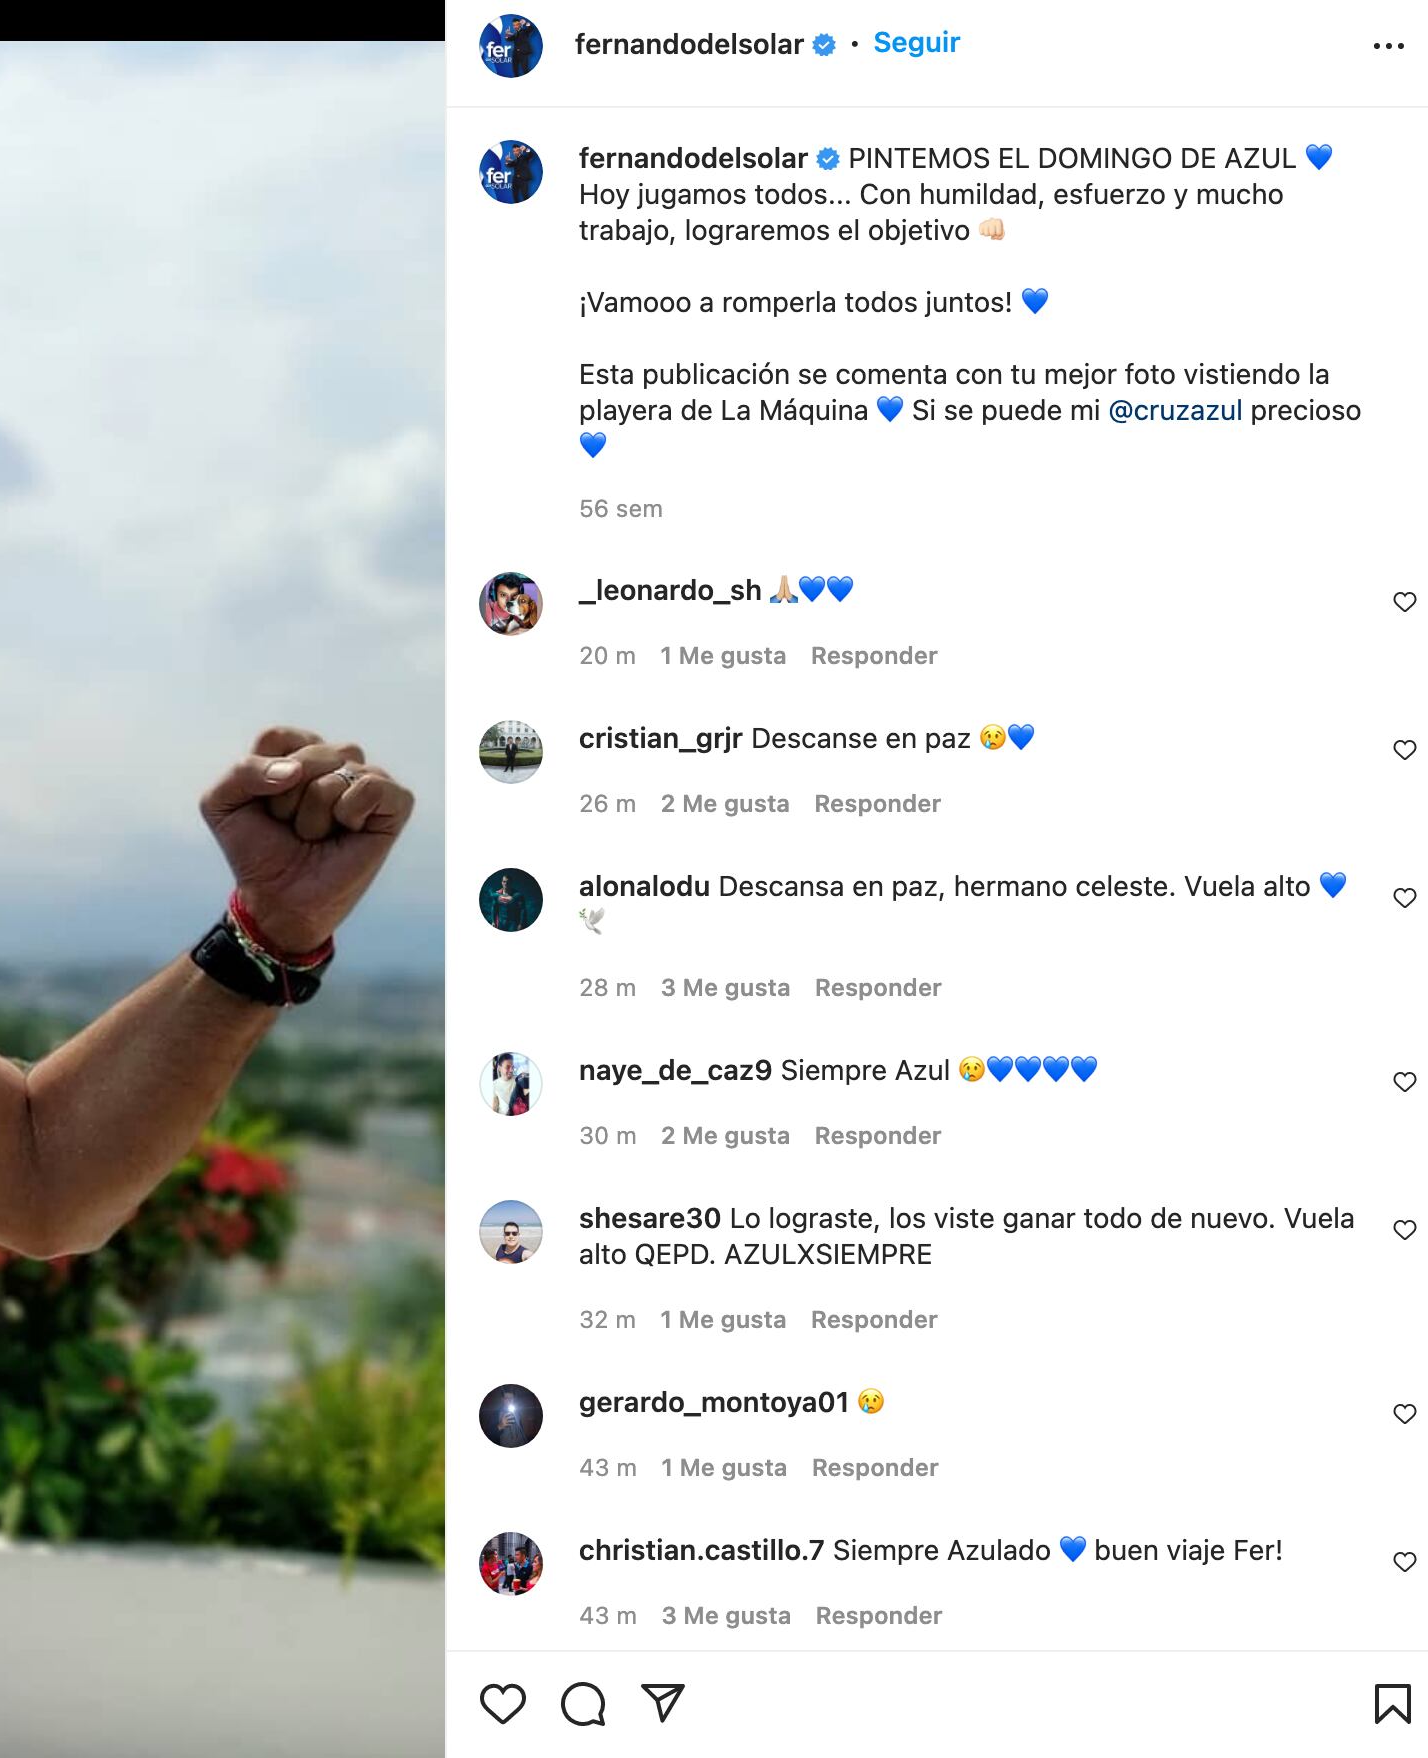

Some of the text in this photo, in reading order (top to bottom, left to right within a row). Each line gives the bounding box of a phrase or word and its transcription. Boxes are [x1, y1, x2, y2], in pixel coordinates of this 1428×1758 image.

[575, 30, 961, 58] fernandodelsolar Seguir
[579, 147, 1296, 169] fernandodelsolar PINTEMOS EL DOMINGO DE AZUL
[581, 183, 1283, 209] Hoy jugamos todos... Con humildad, esfuerzo y mucho
[579, 219, 969, 245] trabajo, lograremos el objetivo
[581, 291, 1011, 317] ¡Vamooo a romperla todos juntos!
[581, 362, 1328, 389] Esta publicación se comenta con tu mejor foto vistiendo la
[581, 398, 1361, 425] playera de La Máquina Si se puede mi @cruzazul precioso
[581, 499, 662, 517] 56 sem
[578, 579, 761, 605] _leonardo_sh
[581, 646, 635, 664] 20 m
[662, 647, 785, 669] 1 Me gusta
[813, 646, 938, 668] Responder
[580, 726, 970, 753] cristian_grjr Descanse en paz
[581, 794, 635, 812] 26 m
[662, 794, 789, 817] 2 Me gusta
[816, 794, 941, 816] Responder
[580, 875, 1310, 901] alonalodu Descansa en paz, hermano celeste. Vuela alto
[581, 978, 635, 996] 28 m
[662, 978, 789, 1000] 3 Me gusta
[817, 978, 942, 1000] Responder
[580, 1059, 949, 1085] naye_de_caz9 Siempre Azul
[581, 1126, 635, 1144] 30 m
[662, 1126, 789, 1149] 2 Me gusta
[816, 1126, 941, 1148] Responder
[580, 1207, 1354, 1233] shesare30 Lo lograste, los viste ganar todo de nuevo. Vuela
[580, 1243, 931, 1266] alto QEPD. AZULXSIEMPRE
[581, 1310, 635, 1328] 32 m
[662, 1311, 785, 1333] 1 Me gusta
[813, 1310, 938, 1332] Responder
[580, 1391, 847, 1417] gerardo_montoya01
[580, 1459, 636, 1476] 43 m
[662, 1459, 786, 1481] 1 Me gusta
[814, 1458, 939, 1480] Responder
[580, 1538, 1281, 1565] christian.castillo.7 Siempre Azulado buen viaje Fer!
[580, 1607, 636, 1624] 43 m
[663, 1606, 790, 1629] 3 Me gusta
[817, 1606, 942, 1628] Responder
